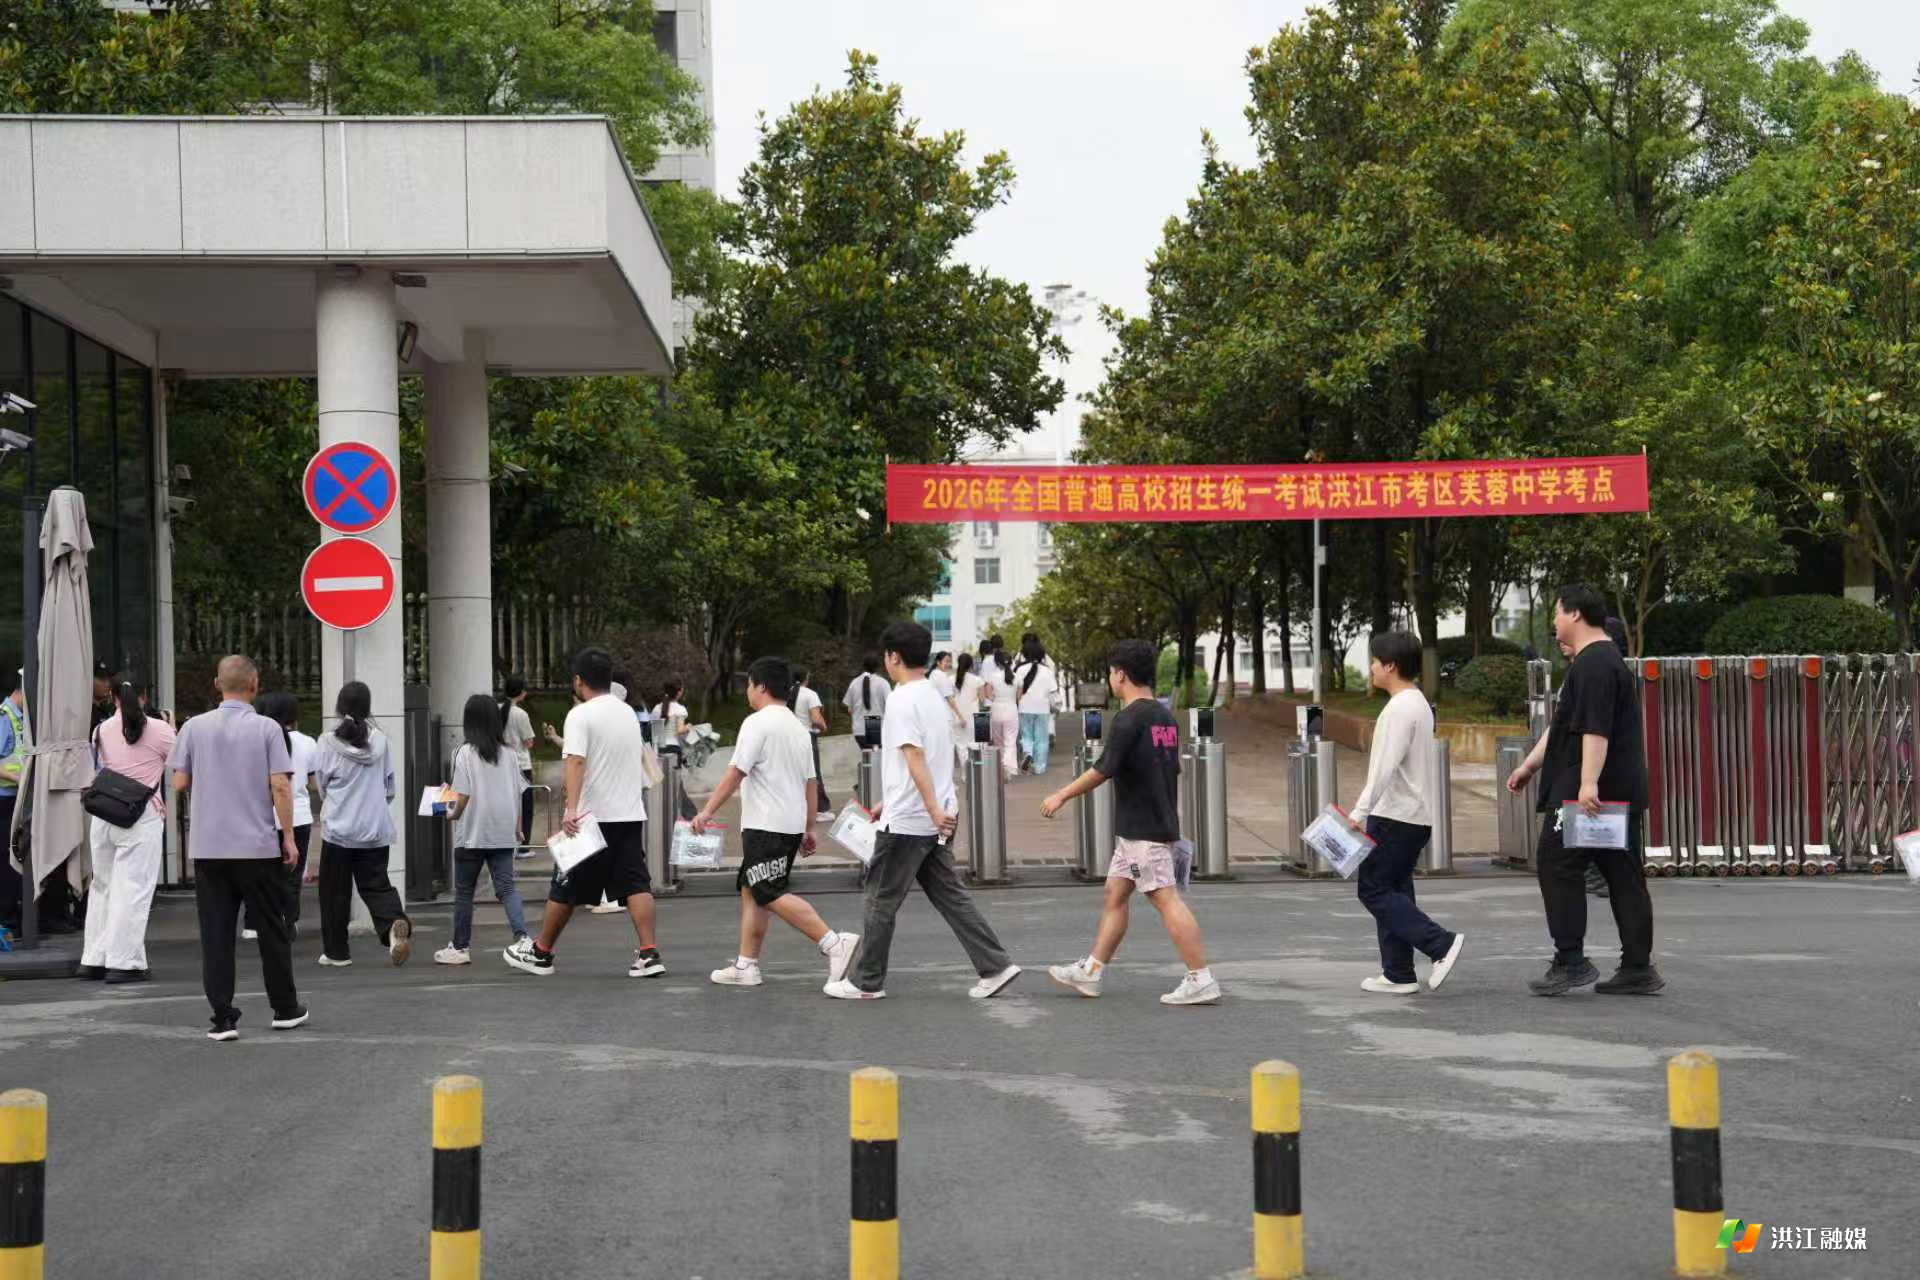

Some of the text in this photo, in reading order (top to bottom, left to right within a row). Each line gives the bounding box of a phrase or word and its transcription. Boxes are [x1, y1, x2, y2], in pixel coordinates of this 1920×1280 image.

[922, 466, 1616, 512] 2026年全国普通高校招生统一考试洪江市考区芙蓉中学考点
